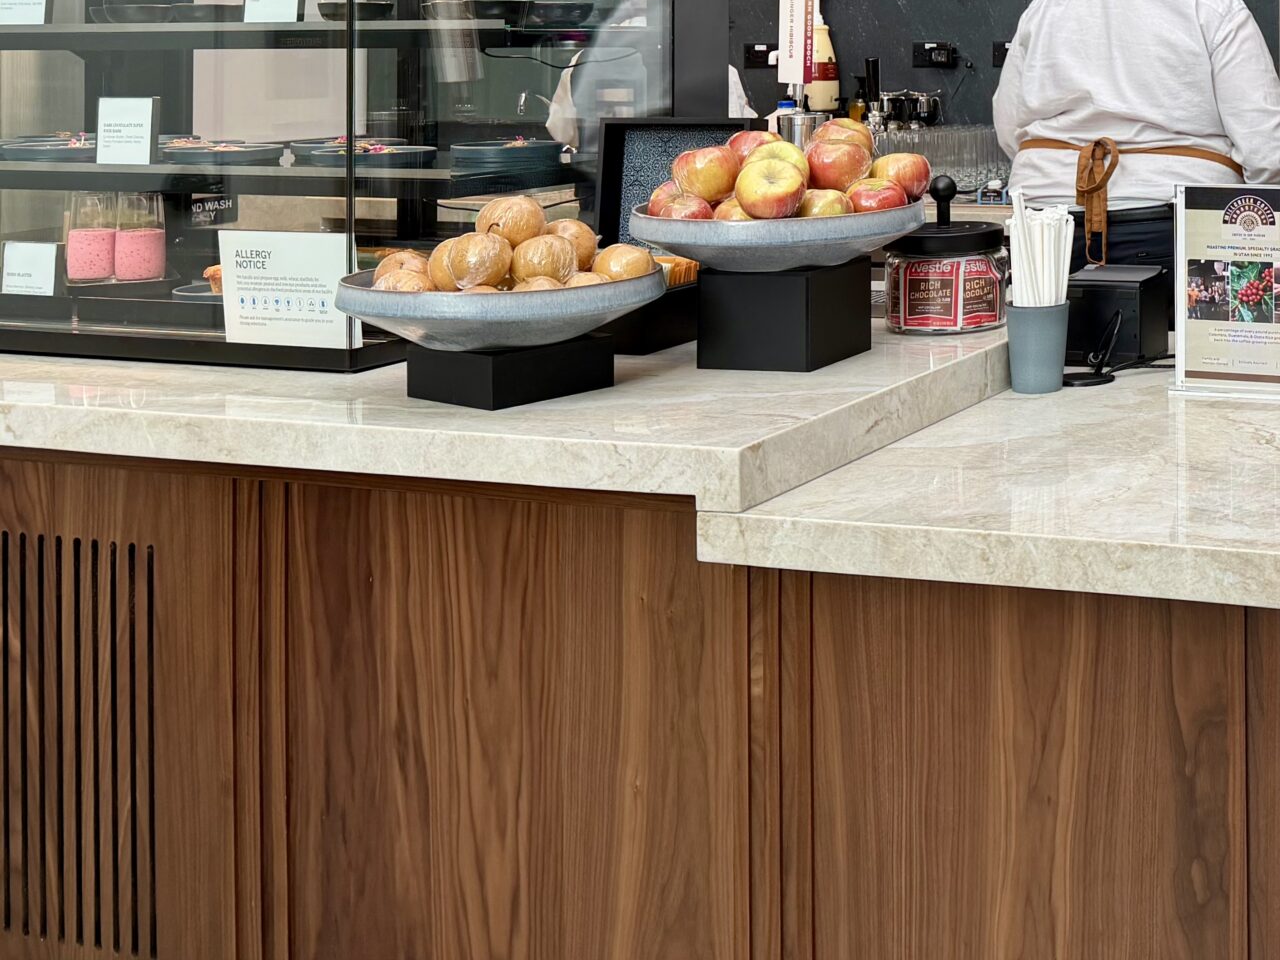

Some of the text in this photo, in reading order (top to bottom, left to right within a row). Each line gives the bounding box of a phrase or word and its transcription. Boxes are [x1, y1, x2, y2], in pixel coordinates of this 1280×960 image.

[205, 199, 232, 210] WASH
[235, 250, 272, 260] ALLERGY
[236, 260, 267, 269] NOTICE
[920, 281, 941, 290] RICH
[966, 279, 984, 290] RICH
[910, 289, 951, 299] CHOCOLATE
